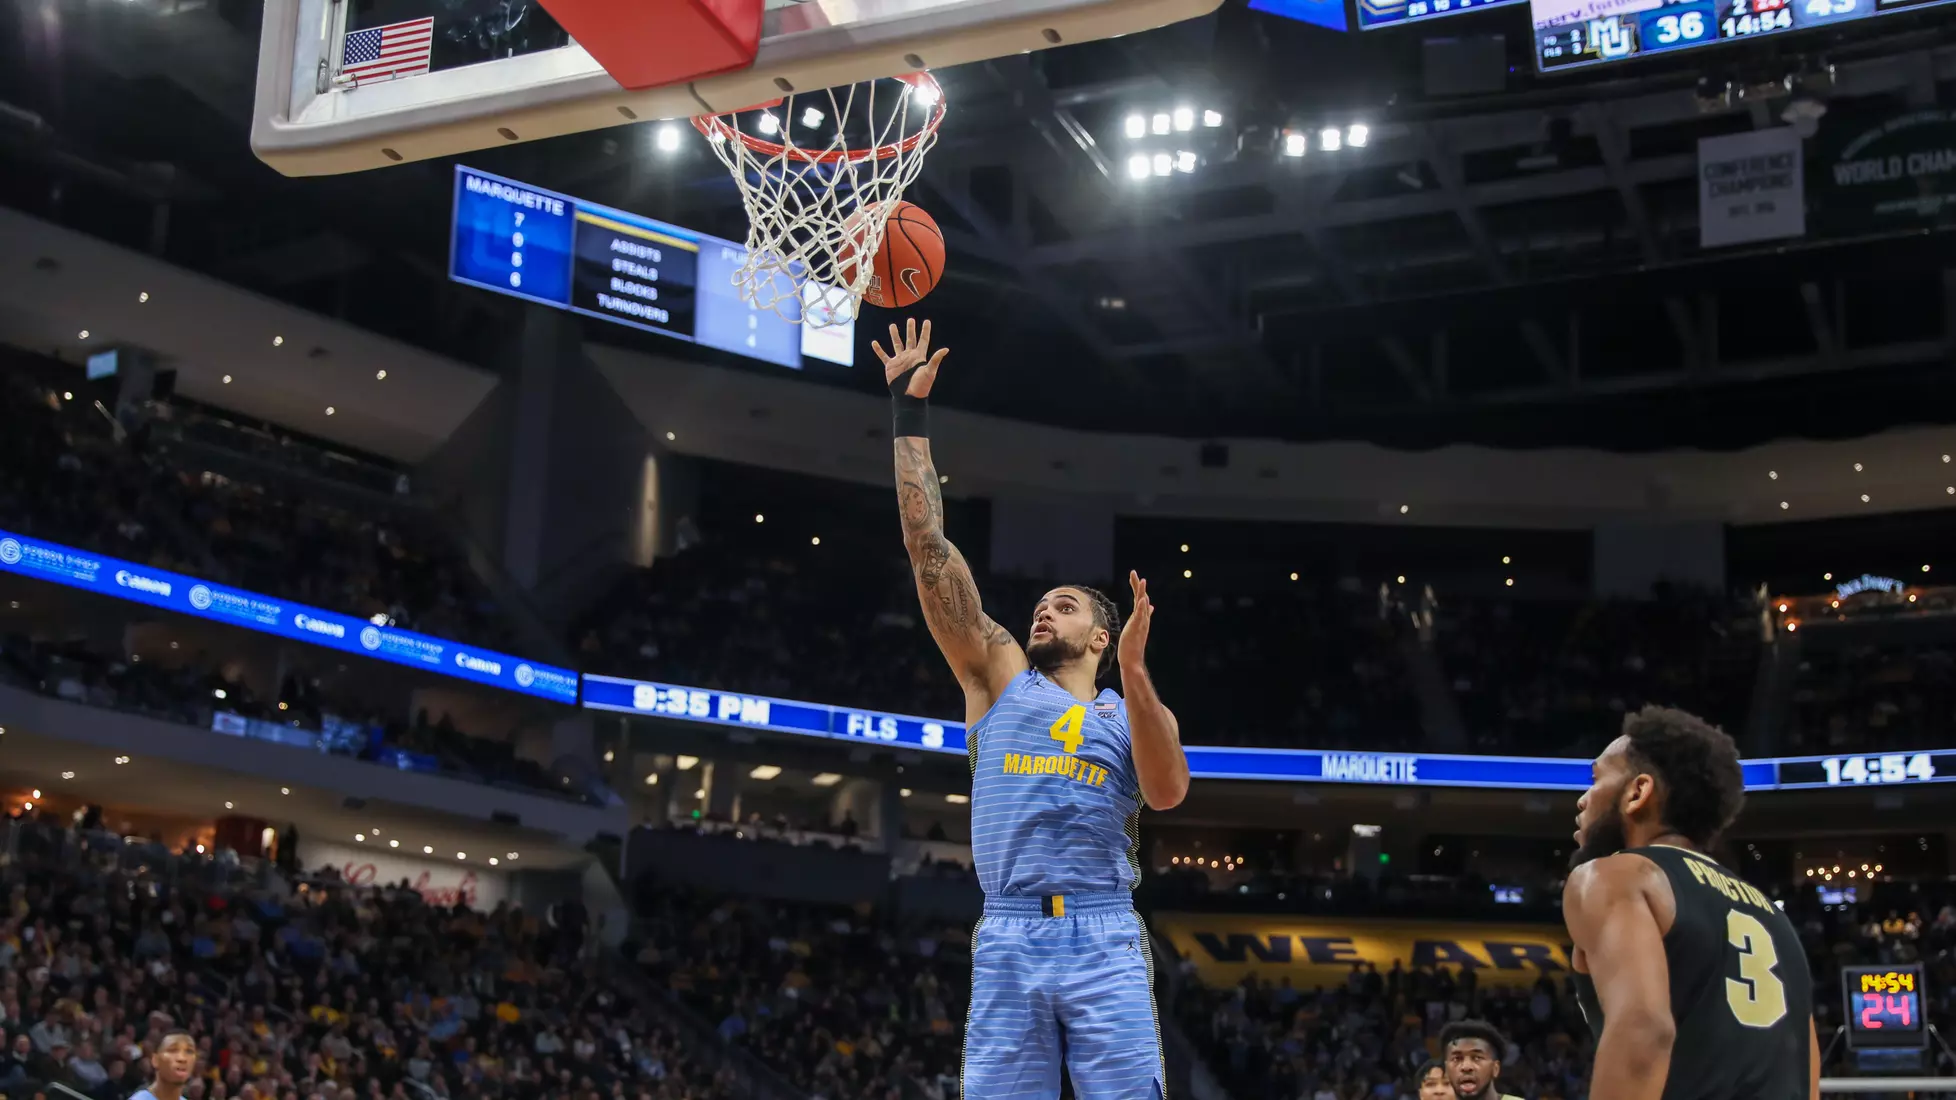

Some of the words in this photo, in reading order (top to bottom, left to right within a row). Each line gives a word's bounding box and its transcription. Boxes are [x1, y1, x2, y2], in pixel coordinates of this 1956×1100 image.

[1656, 11, 1705, 43] 36
[1721, 8, 1793, 37] 14:54
[1833, 156, 1903, 186] WORLD
[466, 175, 565, 216] MARQUETTE
[514, 212, 525, 228] 7
[610, 238, 662, 263] ASSISTS
[611, 258, 659, 281] STEALS
[610, 276, 658, 301] BLOCKS
[596, 293, 670, 323] TURNOVERS
[115, 569, 172, 597] Canon
[294, 613, 345, 638] Canon
[455, 652, 502, 676] Canon
[633, 684, 711, 718] 9:35
[718, 695, 770, 725] PM
[847, 714, 898, 740] FLS
[921, 723, 944, 750] 3
[1050, 704, 1087, 754] 4
[1003, 753, 1109, 787] MARQUETTE
[1321, 753, 1418, 783] MARQUETTE
[1821, 753, 1935, 785] 14:54
[1682, 857, 1775, 914] PROCTOR
[1194, 932, 1358, 964] WE
[1411, 939, 1574, 971] AR
[1725, 909, 1787, 1028] 3
[1860, 972, 1914, 994] 14:54
[1861, 993, 1911, 1029] 24
